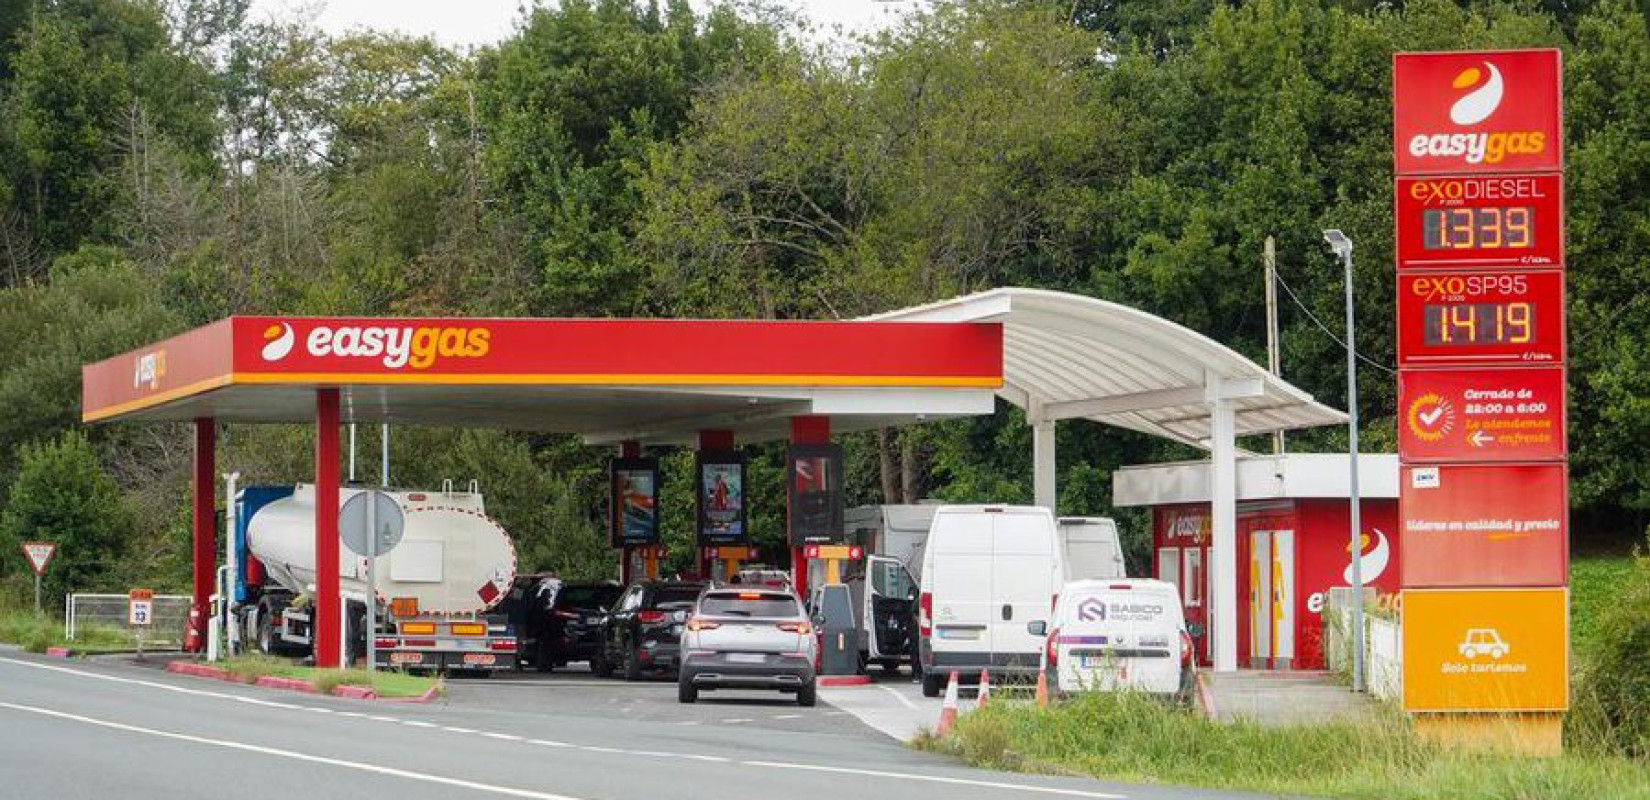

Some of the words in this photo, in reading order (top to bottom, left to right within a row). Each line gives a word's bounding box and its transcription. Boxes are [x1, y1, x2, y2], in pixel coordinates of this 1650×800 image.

[1408, 131, 1546, 164] easygas
[1440, 206, 1529, 249] 1.339
[1440, 302, 1531, 344] 1.419
[307, 326, 491, 369] easygas
[1464, 388, 1515, 399] Cerrado
[1517, 388, 1533, 399] de
[1506, 404, 1514, 413] a
[1449, 521, 1463, 531] en
[1466, 519, 1513, 531] calidad
[1515, 520, 1522, 533] y
[1523, 519, 1560, 532] precio
[1442, 662, 1468, 675] Solo
[1470, 662, 1528, 673] turismos
